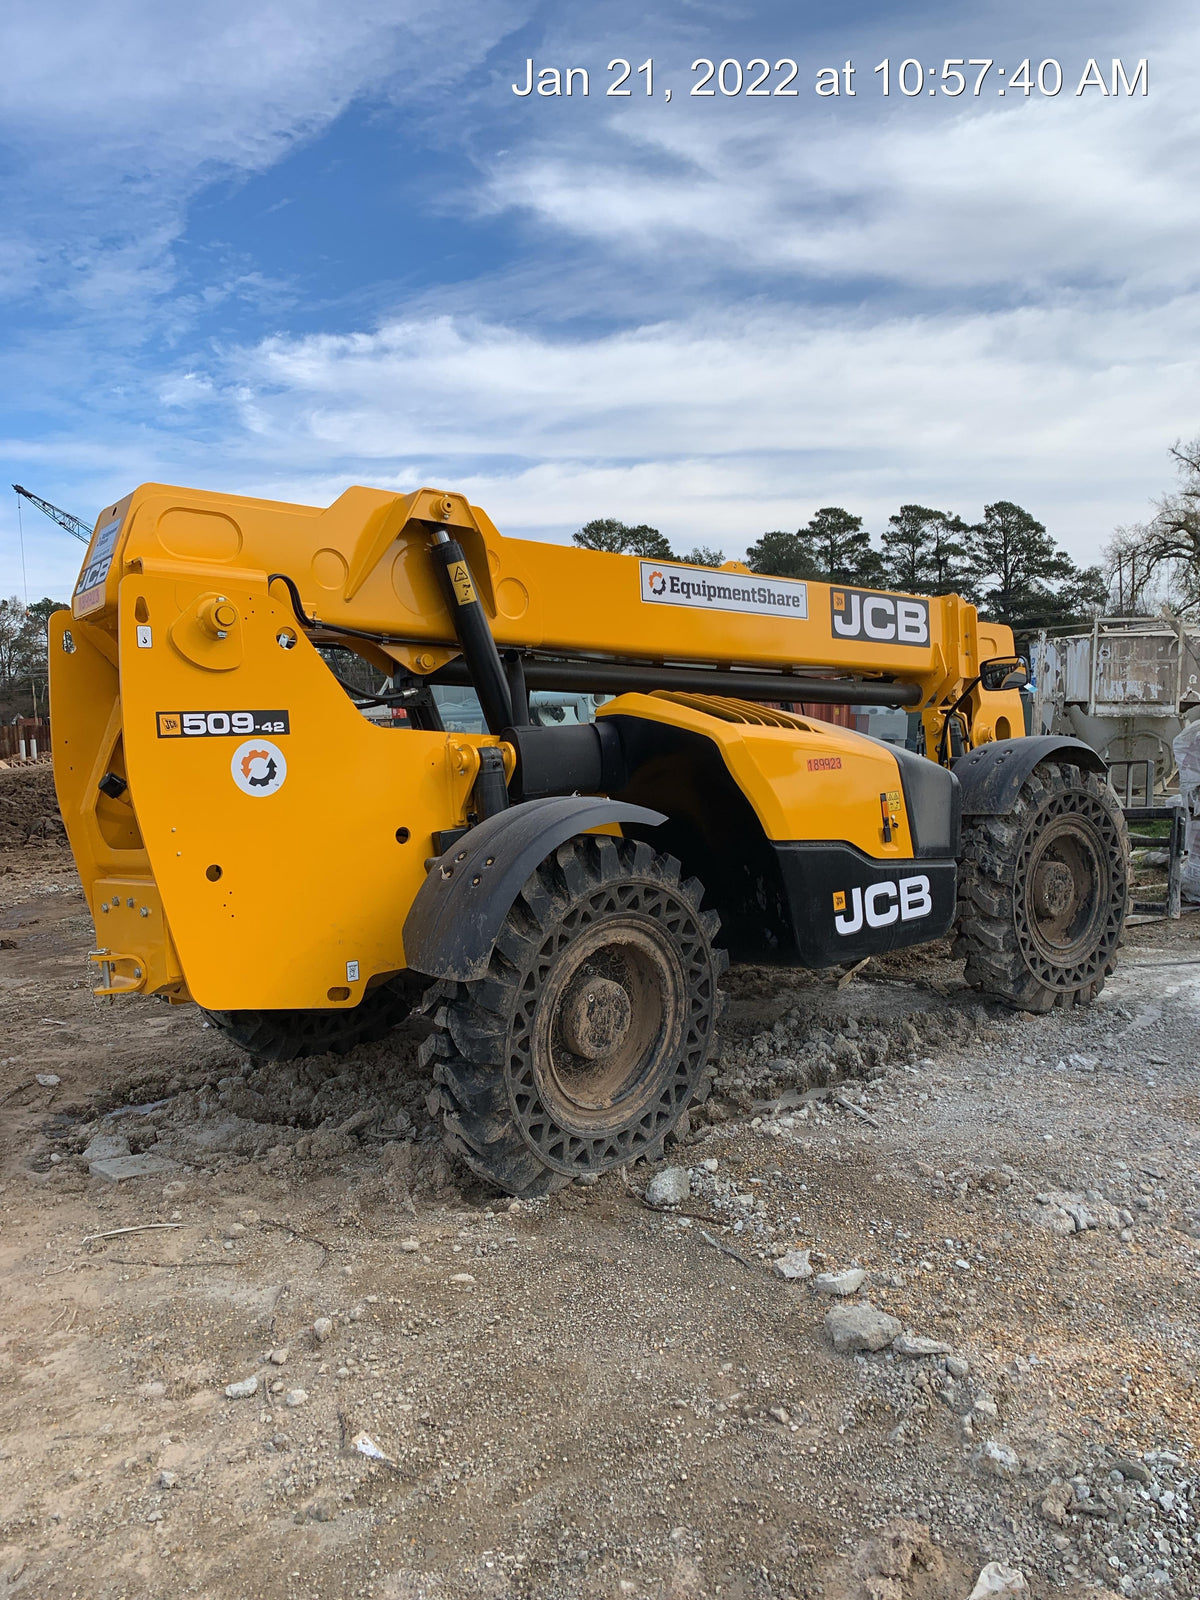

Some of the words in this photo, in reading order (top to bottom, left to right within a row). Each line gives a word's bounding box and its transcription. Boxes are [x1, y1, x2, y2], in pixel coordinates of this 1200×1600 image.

[76, 557, 112, 595] JCB
[670, 576, 800, 607] EquipmentShare
[834, 594, 928, 643] JCB
[183, 712, 285, 735] 509-42
[807, 757, 842, 772] 189923
[835, 874, 932, 935] JCB
